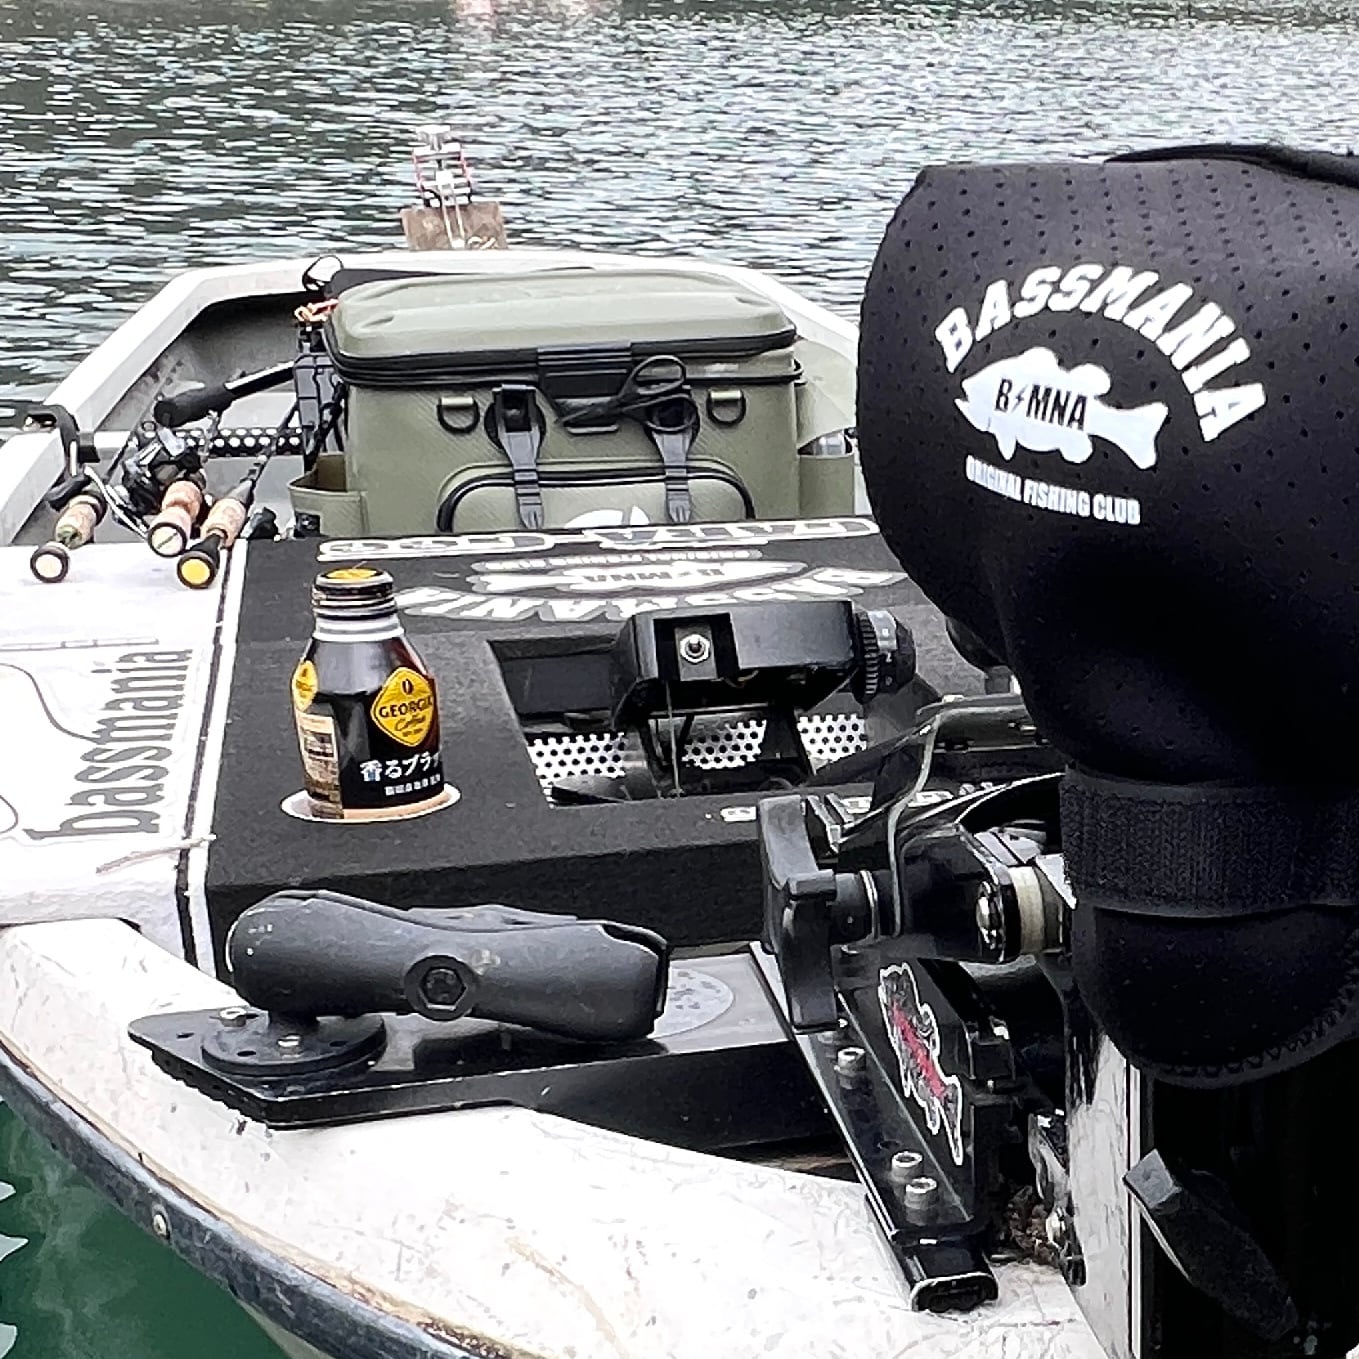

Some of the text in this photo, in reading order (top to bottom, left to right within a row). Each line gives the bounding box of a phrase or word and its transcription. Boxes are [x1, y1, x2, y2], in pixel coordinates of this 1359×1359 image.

[935, 264, 1266, 442] BASSMANIA
[965, 454, 1141, 526] ORIGINAL FISHING CLUB
[22, 648, 193, 840] bassmania
